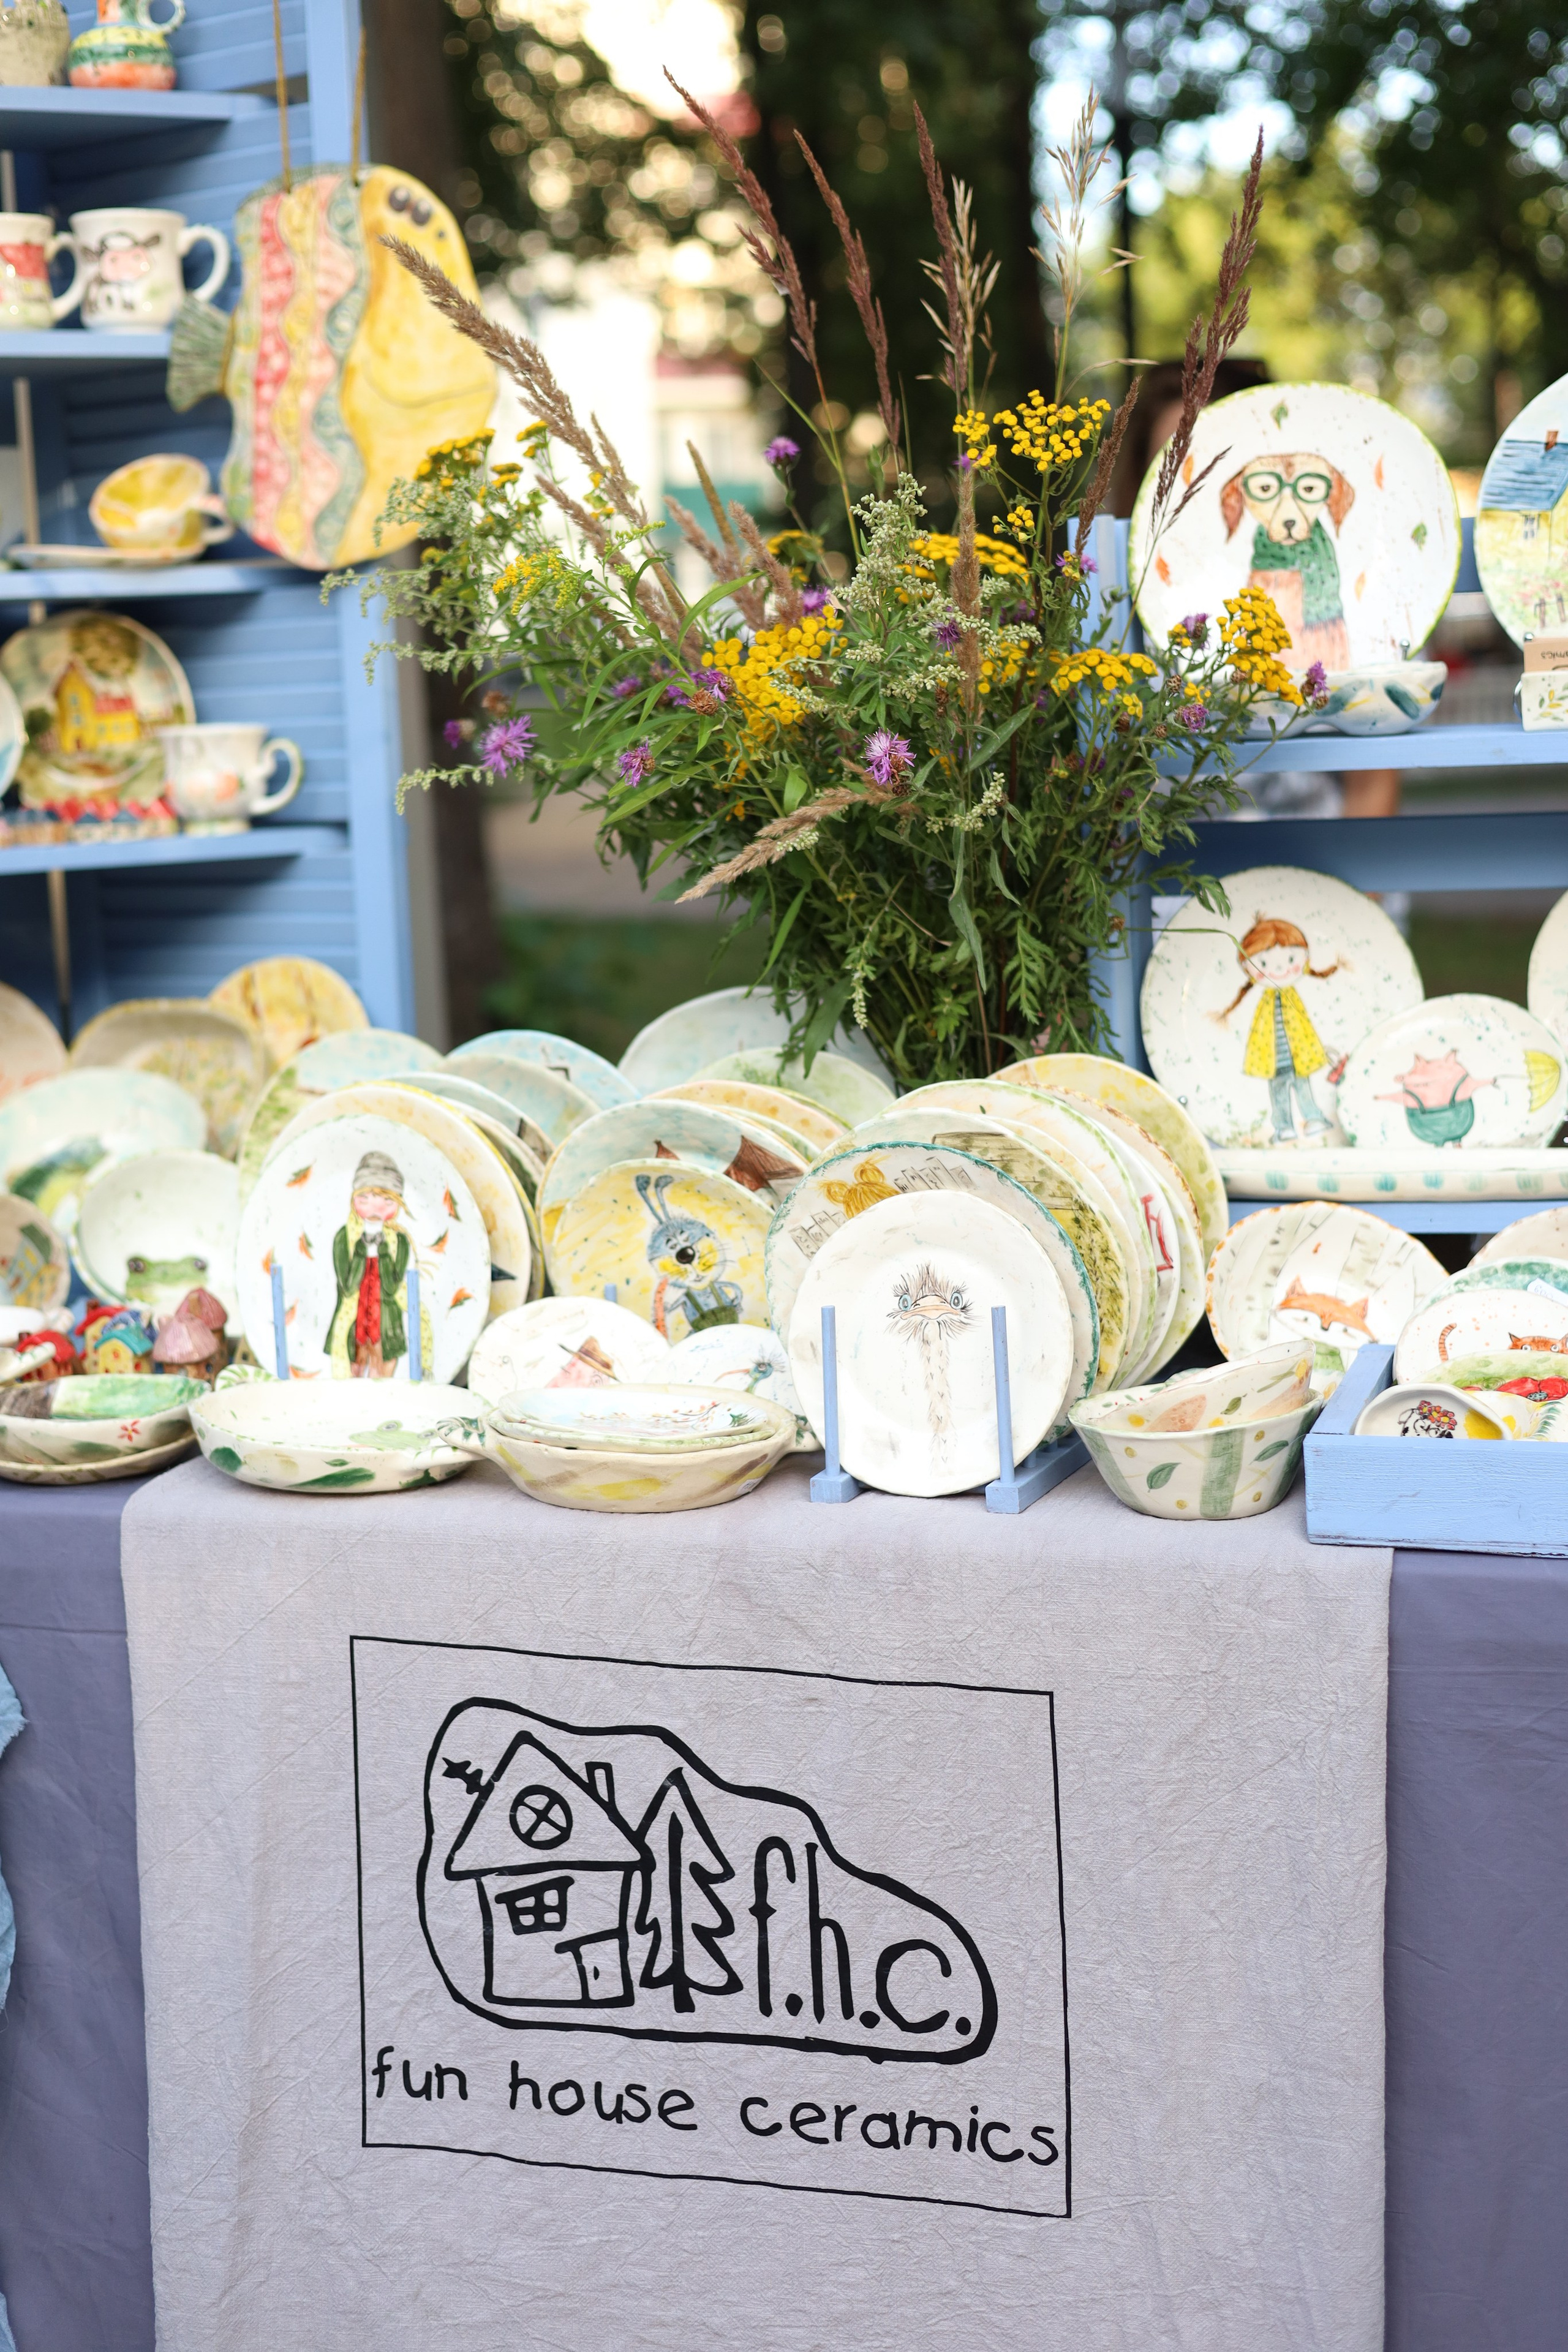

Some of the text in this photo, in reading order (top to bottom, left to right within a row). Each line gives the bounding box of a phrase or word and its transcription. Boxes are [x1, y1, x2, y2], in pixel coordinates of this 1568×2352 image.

[748, 1836, 971, 2035] f.h.c.
[372, 2046, 1059, 2166] fun house ceramics
